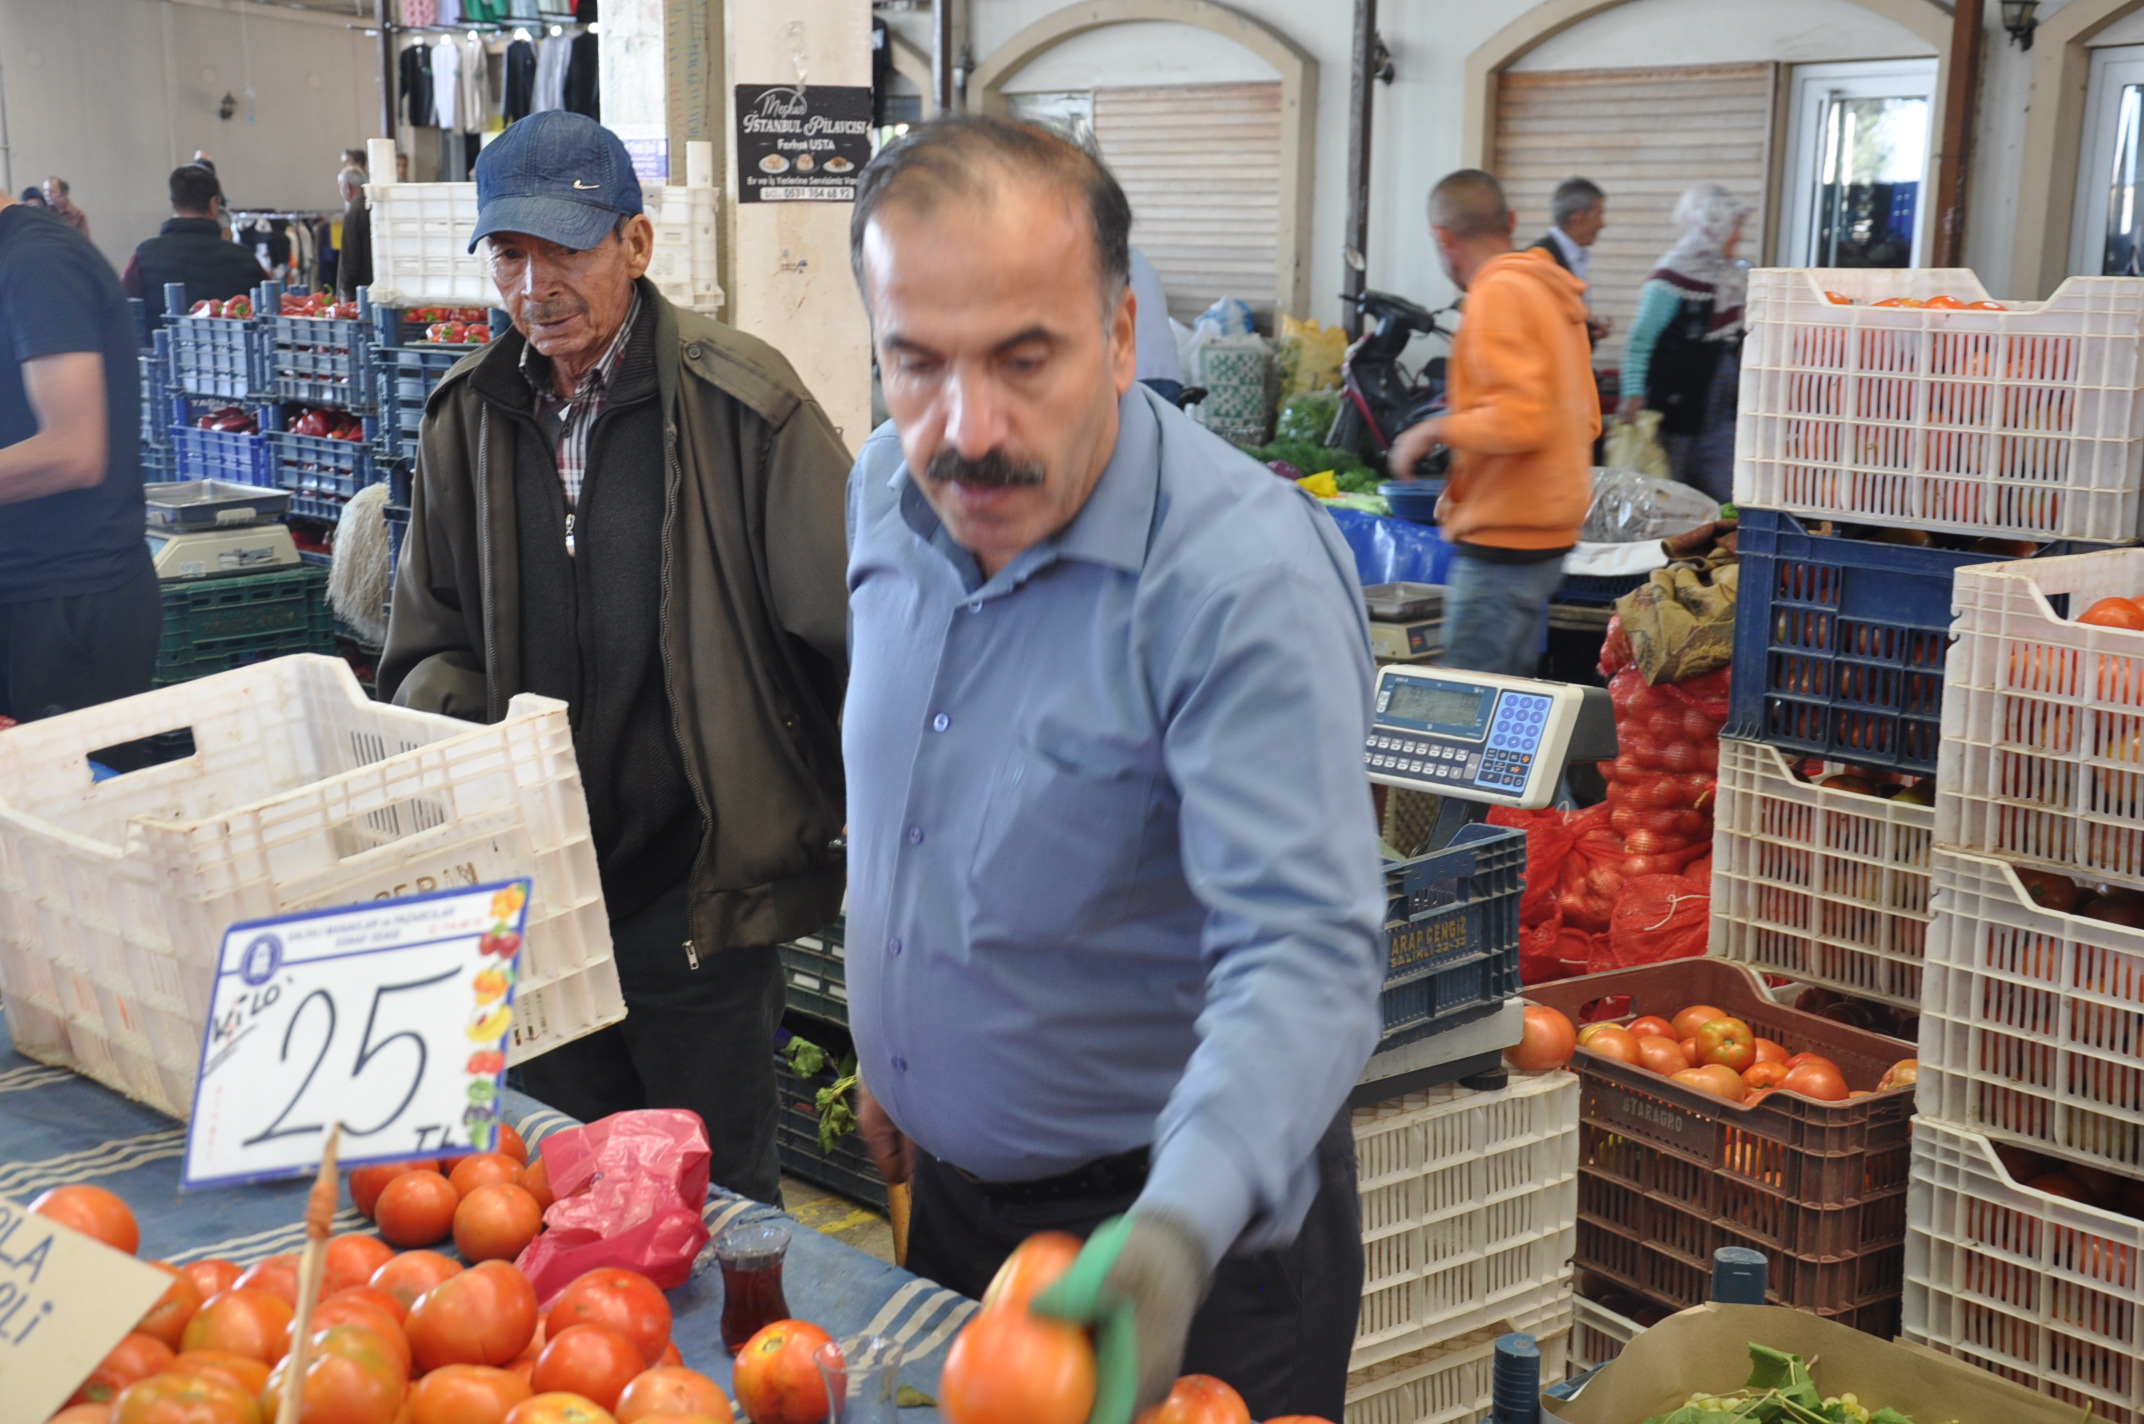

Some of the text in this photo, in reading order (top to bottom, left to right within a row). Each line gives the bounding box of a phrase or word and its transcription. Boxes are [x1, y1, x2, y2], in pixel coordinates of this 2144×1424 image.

[776, 138, 836, 151] Ferhat USTA
[758, 177, 768, 186] ve
[840, 188, 851, 198] 92
[1391, 928, 1423, 957] ARAP
[242, 964, 463, 1149] 25
[1622, 1098, 1683, 1132] STARAGRO
